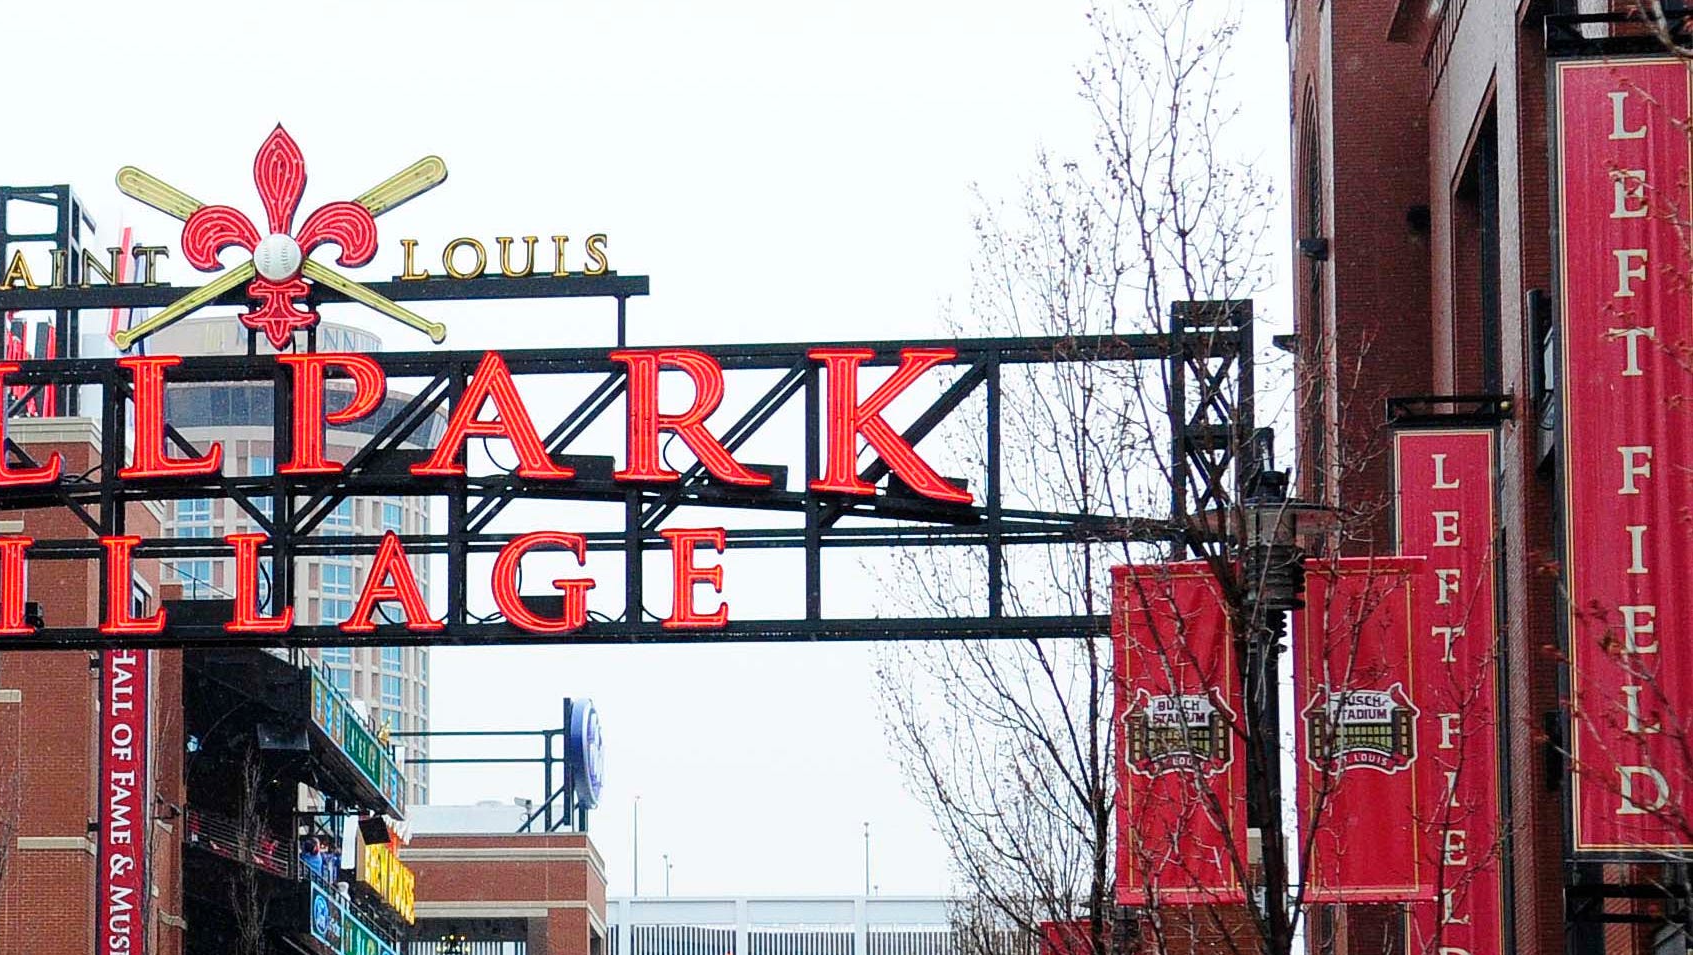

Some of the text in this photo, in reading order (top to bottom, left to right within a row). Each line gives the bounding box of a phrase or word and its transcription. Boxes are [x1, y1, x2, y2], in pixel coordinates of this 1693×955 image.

[399, 233, 609, 281] LOUIS
[1607, 91, 1670, 815] LEFT FIELD
[1431, 453, 1466, 663] LEFT
[111, 649, 136, 716] HALL
[1157, 699, 1200, 711] BUCH
[1342, 695, 1382, 707] USCH
[111, 723, 133, 761] OF
[110, 769, 135, 845] FAME
[109, 853, 134, 879] &
